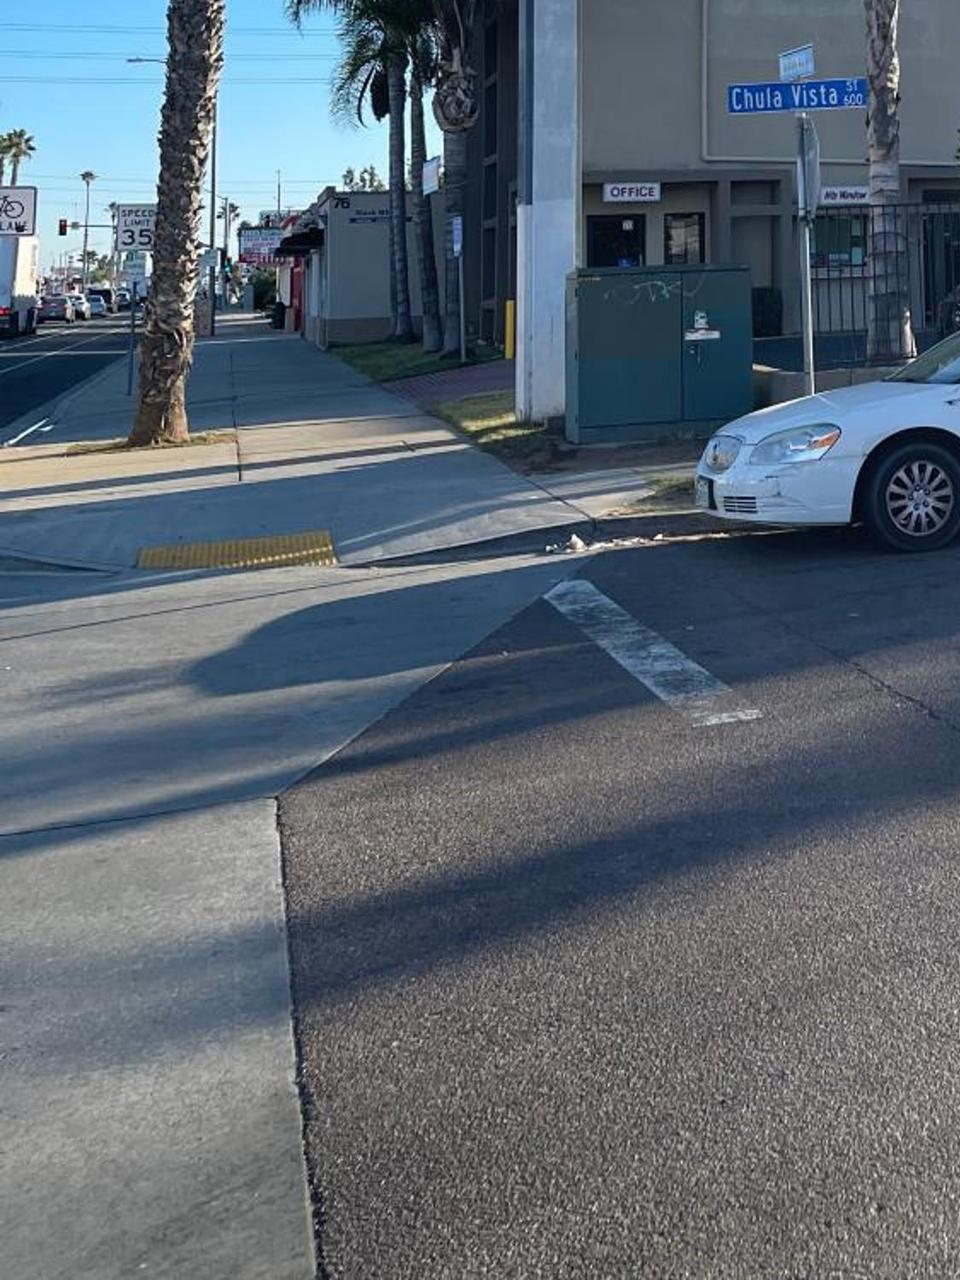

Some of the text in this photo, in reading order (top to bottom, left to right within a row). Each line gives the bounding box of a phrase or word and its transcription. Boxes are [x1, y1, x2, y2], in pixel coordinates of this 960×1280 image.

[731, 84, 838, 110] Chula Vista
[610, 185, 656, 198] OFFICE
[121, 209, 155, 218] SPEED
[124, 218, 151, 228] LIMIT
[121, 228, 153, 247] 35
